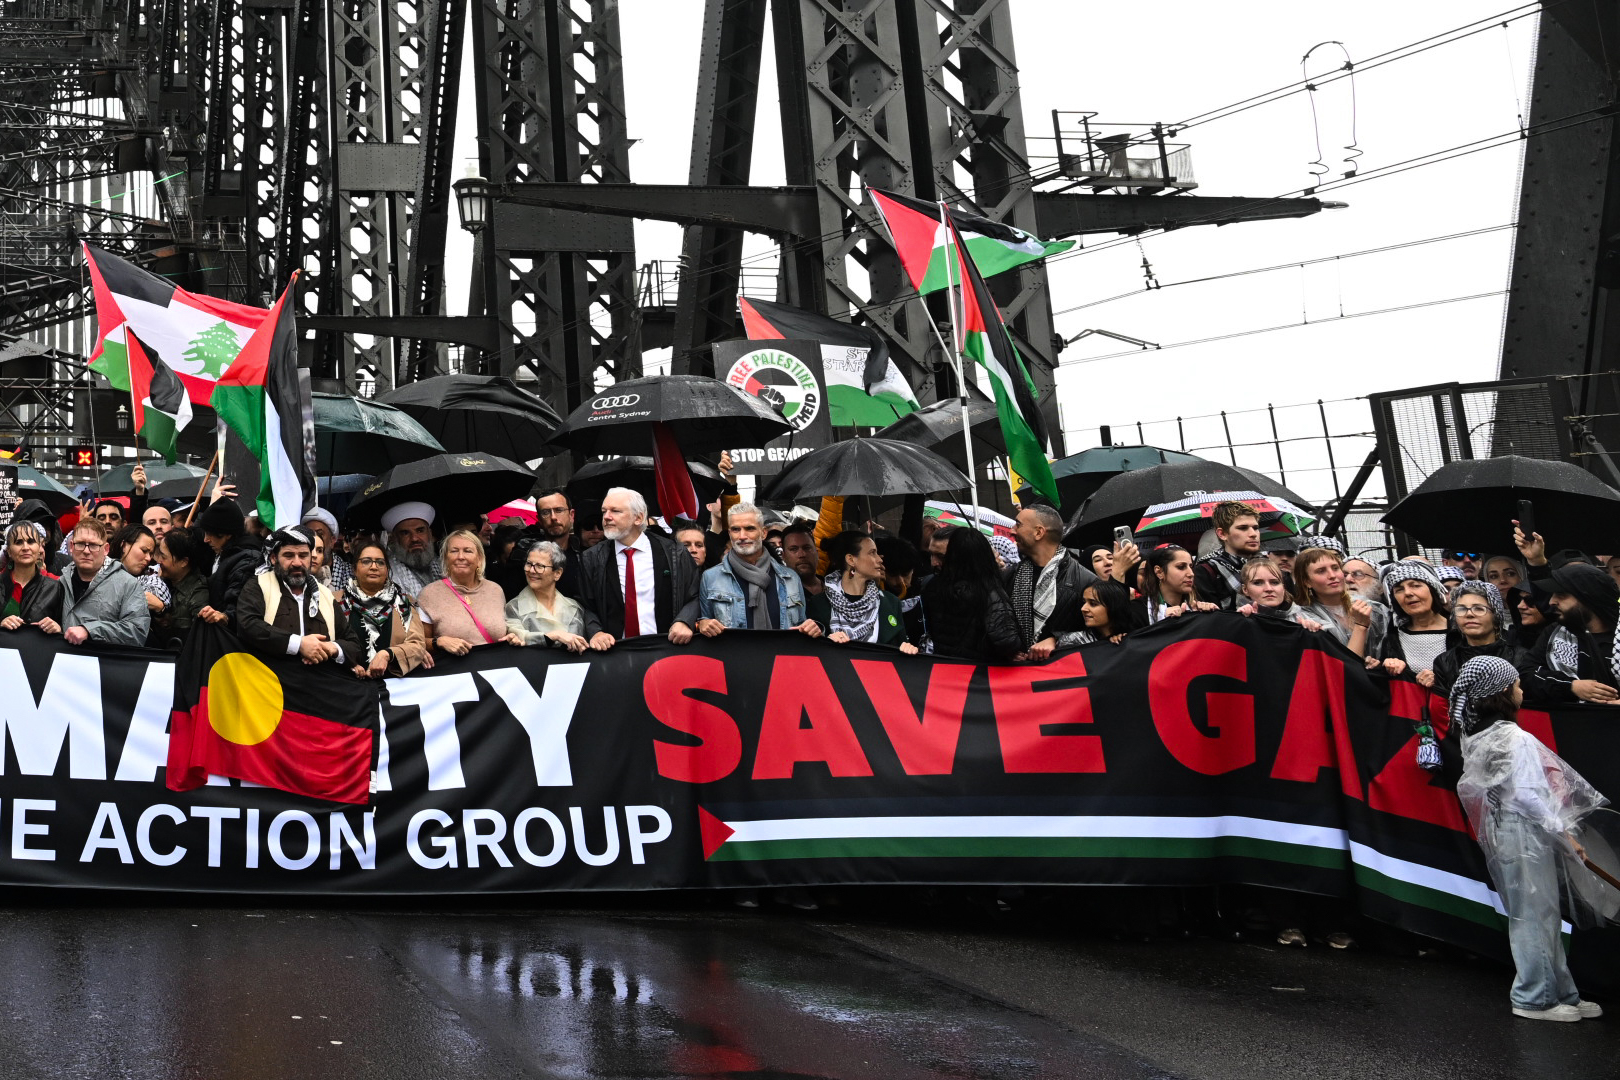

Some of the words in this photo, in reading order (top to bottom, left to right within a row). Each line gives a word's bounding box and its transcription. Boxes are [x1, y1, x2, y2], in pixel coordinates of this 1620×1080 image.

[823, 358, 866, 373] STAR
[846, 347, 869, 360] ST
[730, 361, 753, 389] REE
[752, 352, 816, 391] PALESTINE
[792, 393, 817, 429] THEID
[23, 451, 30, 461] 2
[730, 449, 765, 463] STOP
[767, 447, 814, 462] GENO
[642, 652, 1108, 784] SAVE
[1147, 638, 1568, 846] GAZ
[78, 801, 377, 871] ACTION
[406, 804, 673, 870] GROUP
